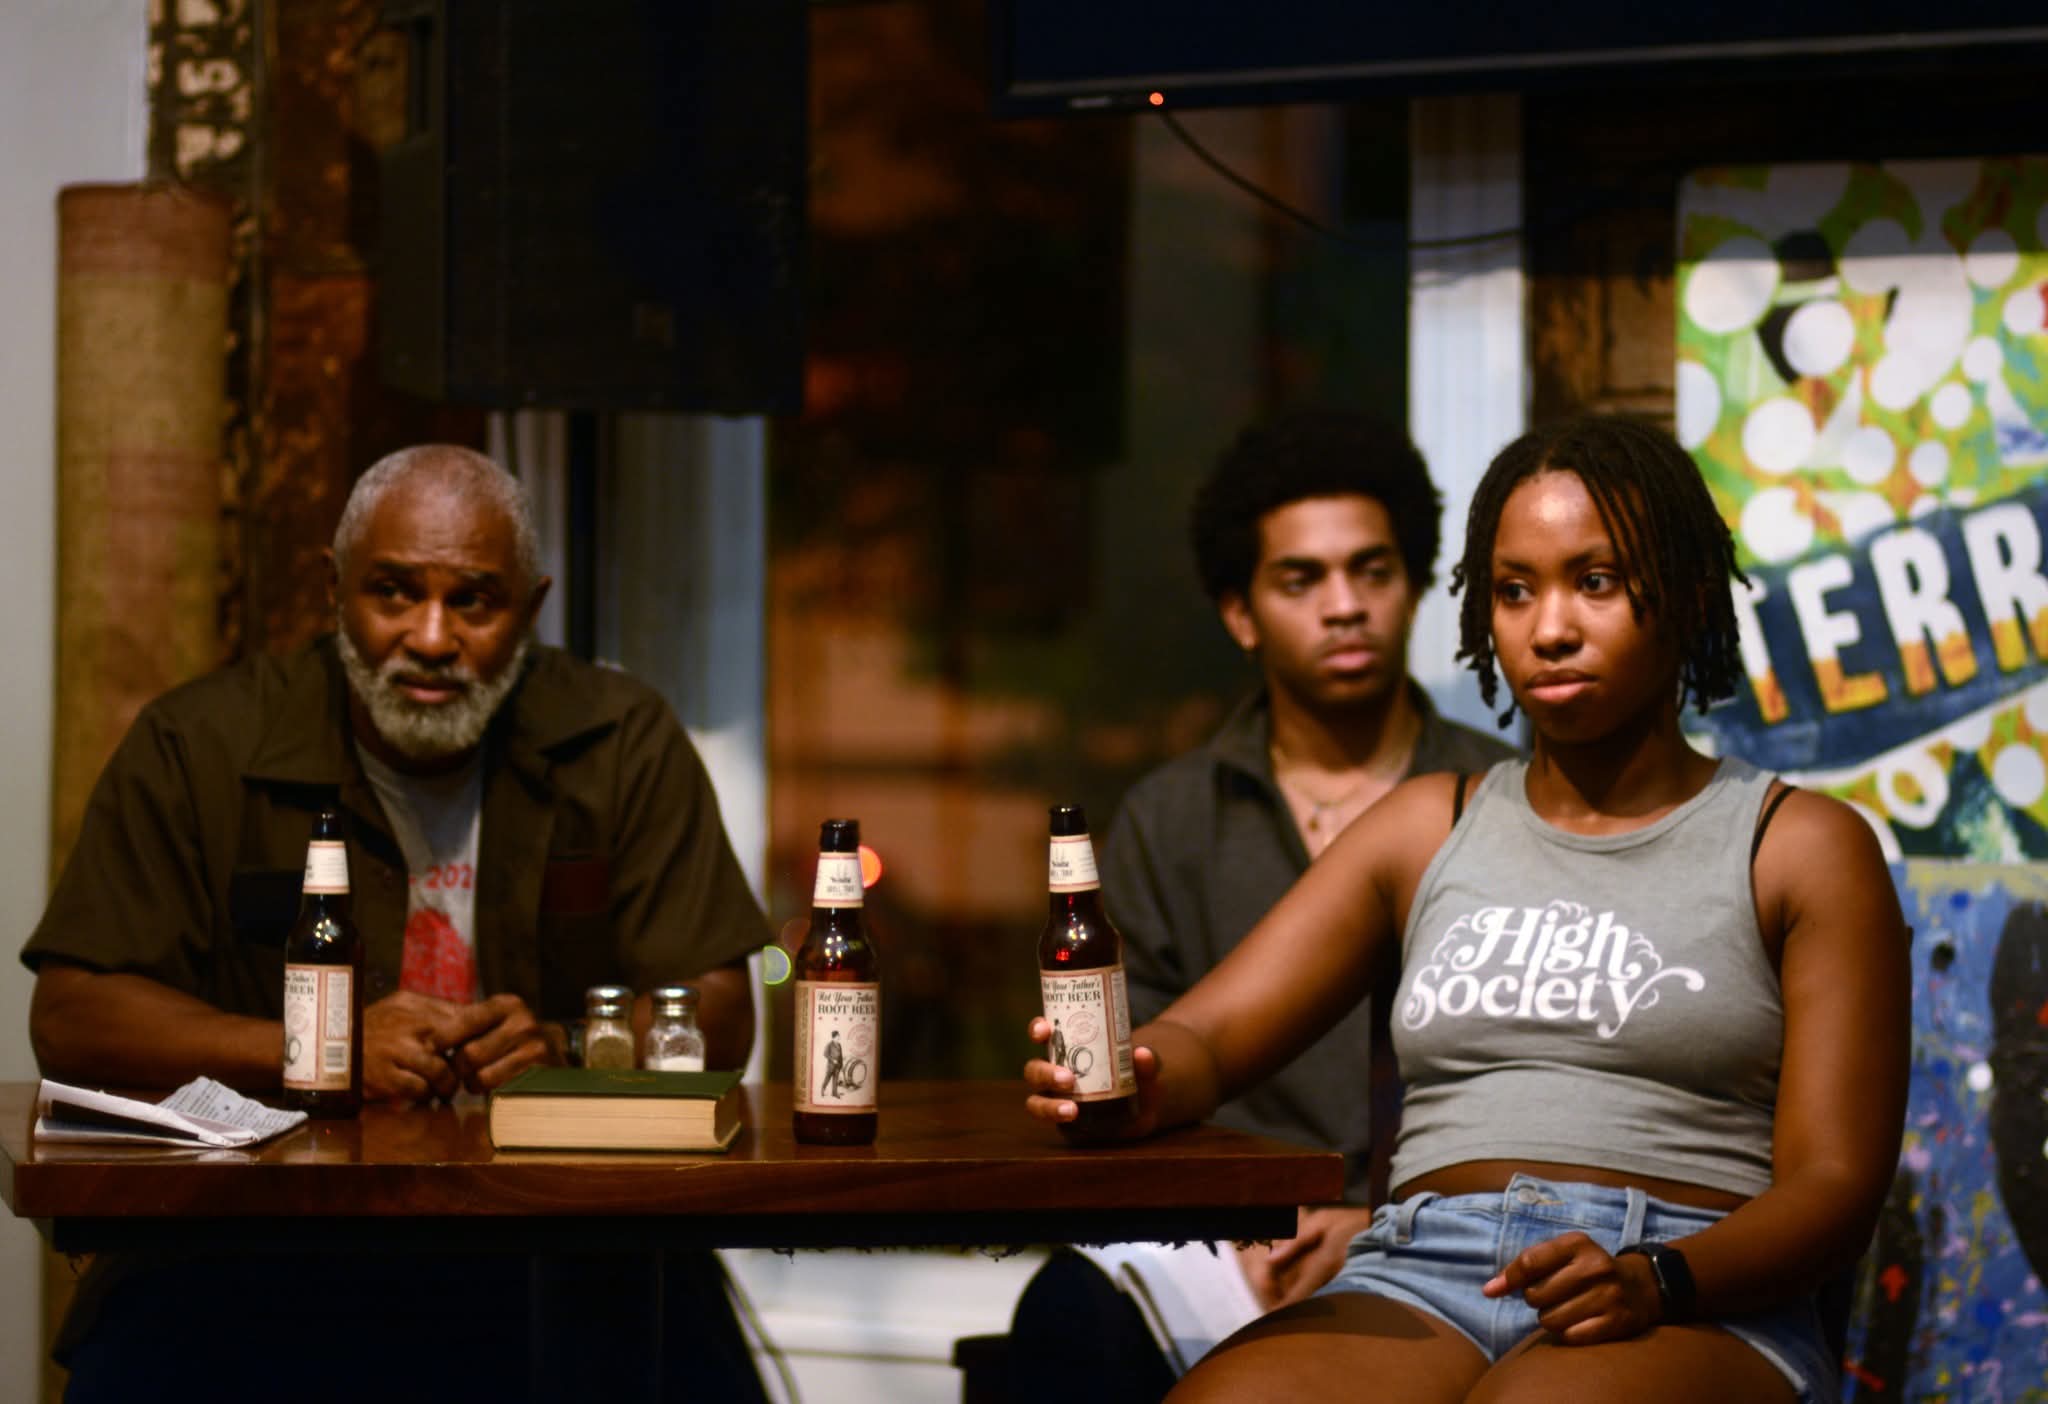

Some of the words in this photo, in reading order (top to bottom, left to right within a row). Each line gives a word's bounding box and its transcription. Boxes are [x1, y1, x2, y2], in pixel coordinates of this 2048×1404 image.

[1449, 900, 1643, 981] High
[817, 1003, 848, 1015] ROOT
[1067, 990, 1101, 1003] BEER
[1402, 964, 1705, 1039] Society
